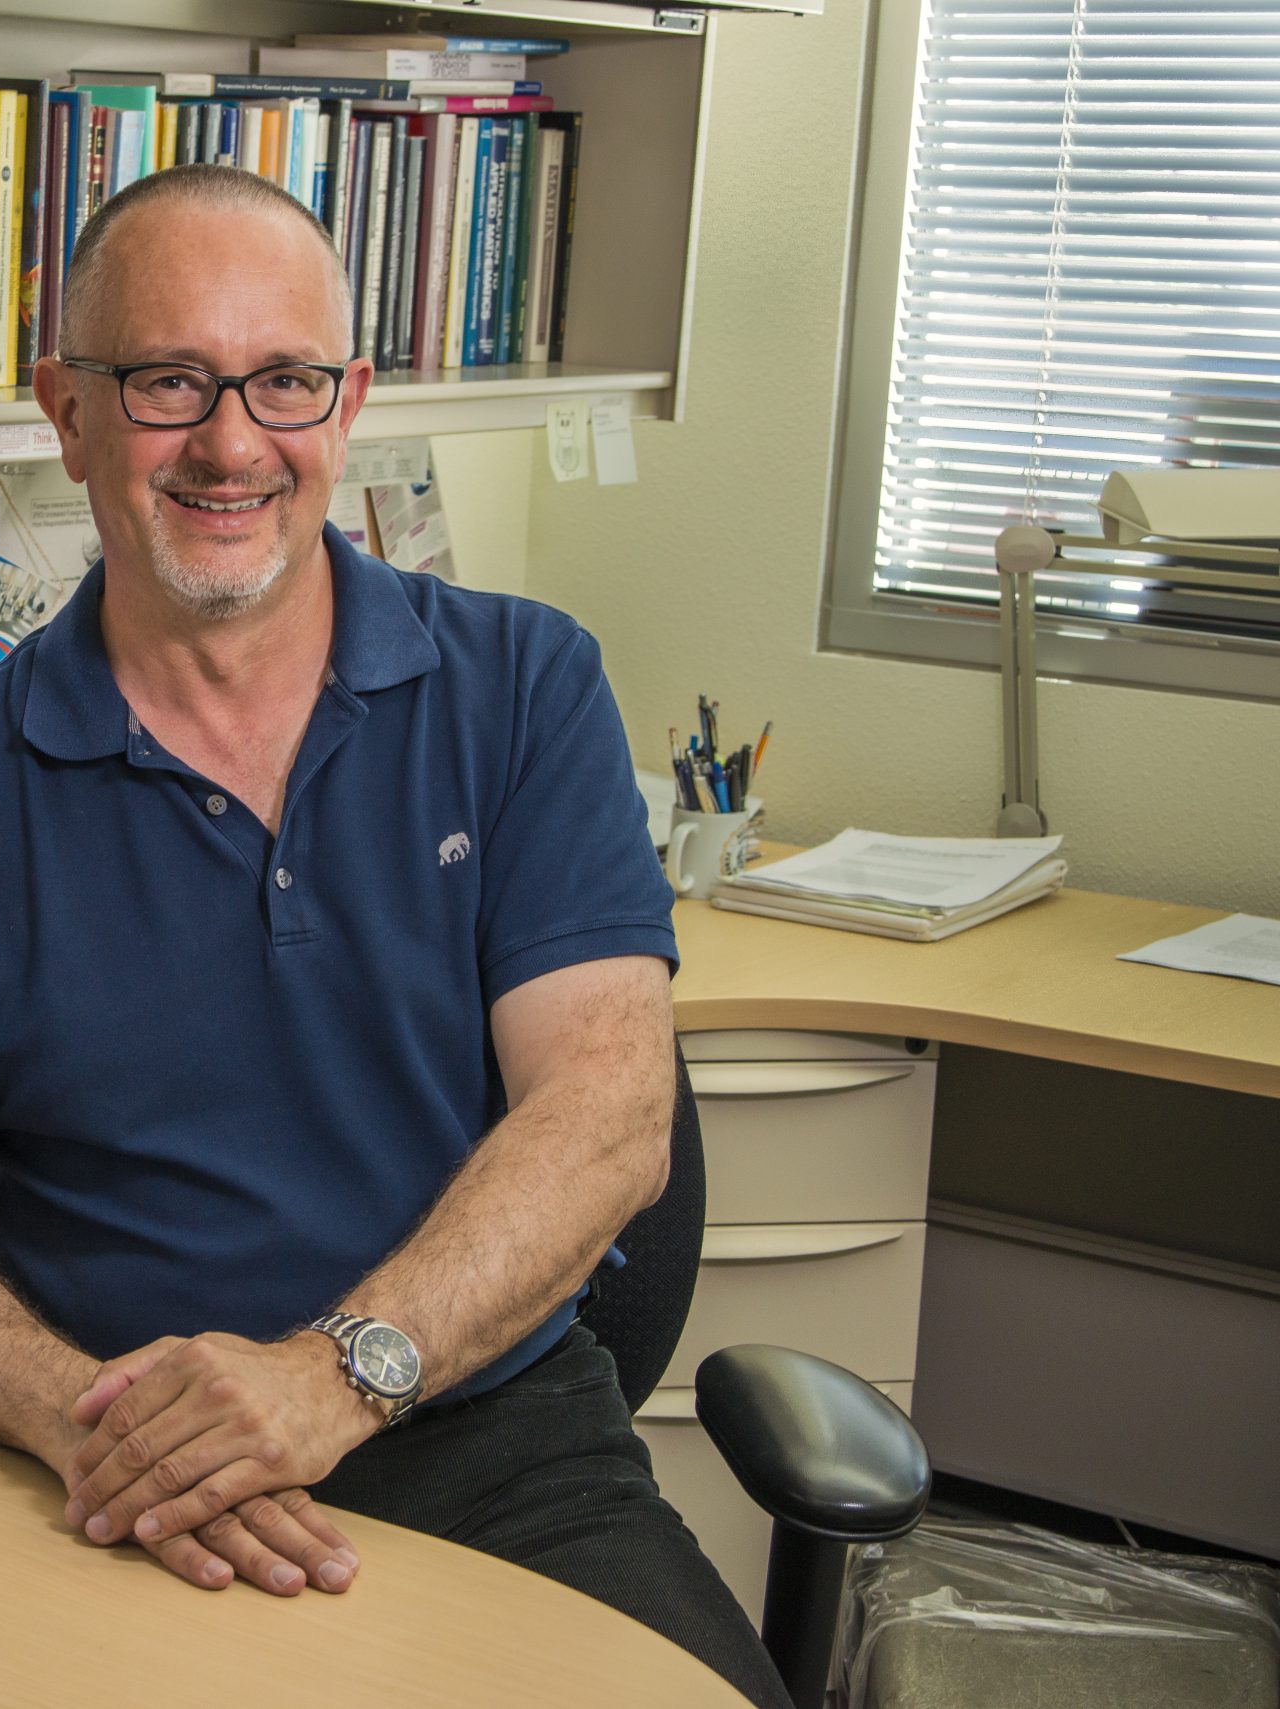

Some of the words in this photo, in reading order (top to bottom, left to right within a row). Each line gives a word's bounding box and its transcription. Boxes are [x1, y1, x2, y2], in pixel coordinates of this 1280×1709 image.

[478, 155, 489, 217] Introduction
[487, 161, 499, 219] APPLIED
[493, 161, 507, 265] INTRODUCTION
[544, 167, 559, 239] MATRIX
[475, 230, 484, 273] Scientific
[481, 223, 497, 321] MATHEMATICS
[470, 275, 481, 331] Computing
[33, 432, 52, 445] Think
